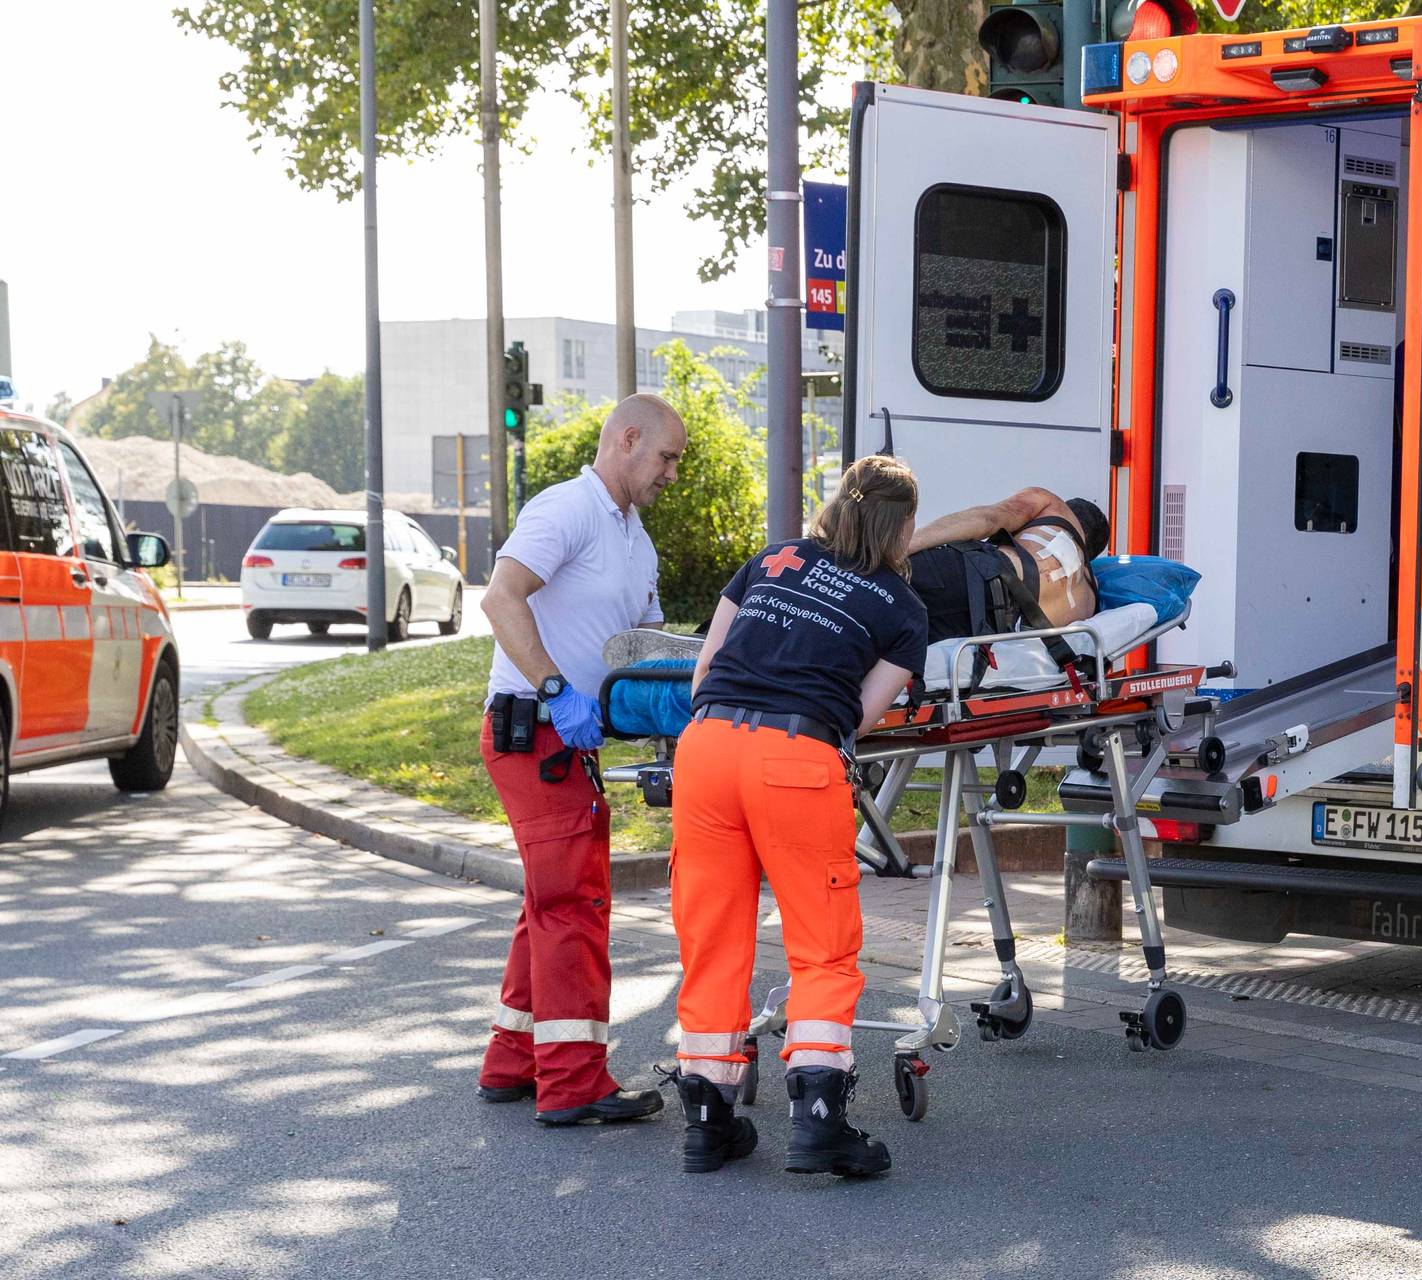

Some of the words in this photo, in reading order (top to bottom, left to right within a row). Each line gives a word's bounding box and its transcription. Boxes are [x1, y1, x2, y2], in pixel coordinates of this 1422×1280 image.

[1325, 129, 1335, 144] 16
[814, 248, 833, 269] Zu
[811, 288, 832, 304] 145
[801, 575, 847, 602] Kreuz
[808, 565, 855, 593] Rotes
[815, 557, 895, 605] Deutsches
[782, 615, 794, 631] V.
[1129, 674, 1193, 694] STOLLENWERK
[1325, 808, 1338, 836] E
[1352, 811, 1381, 838] FW
